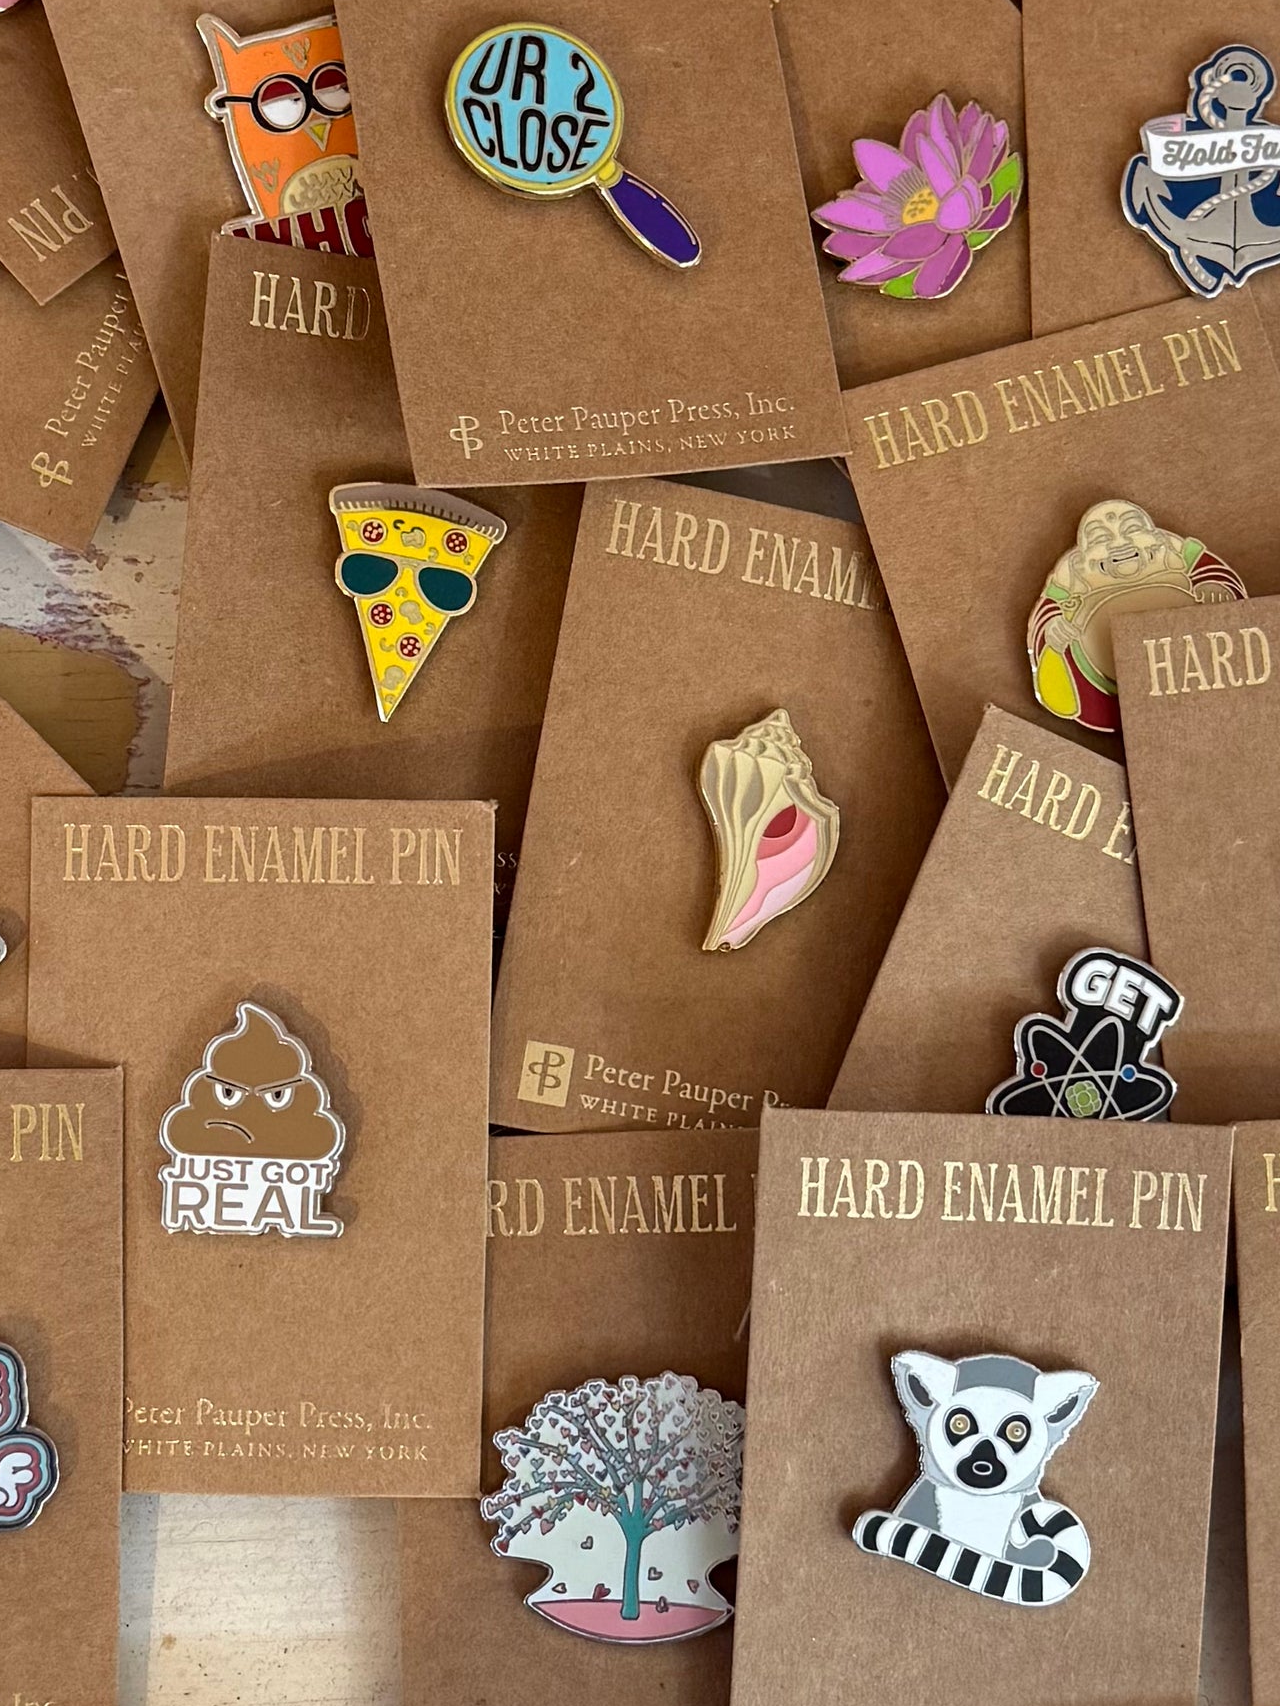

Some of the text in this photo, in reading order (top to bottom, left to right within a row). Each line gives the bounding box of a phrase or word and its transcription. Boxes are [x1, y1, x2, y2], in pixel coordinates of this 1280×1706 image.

[468, 35, 608, 116] UR 2
[463, 97, 611, 174] CLOSE
[1161, 138, 1237, 171] Hold
[498, 390, 796, 439] Peter Pauper Press, Inc.
[863, 319, 1244, 471] HARD ENAMEL PIN
[504, 424, 798, 463] WHITE PLAINS, NEW YORK
[1143, 626, 1273, 697] HARD
[62, 822, 186, 883] HARD
[203, 824, 375, 886] ENAMEL
[390, 826, 464, 887] PIN
[1069, 959, 1172, 1034] GET
[9, 1102, 86, 1164] PIN
[167, 1158, 330, 1183] JUST GOT
[796, 1155, 1208, 1232] HARD ENAMEL PIN
[168, 1181, 336, 1232] REAL
